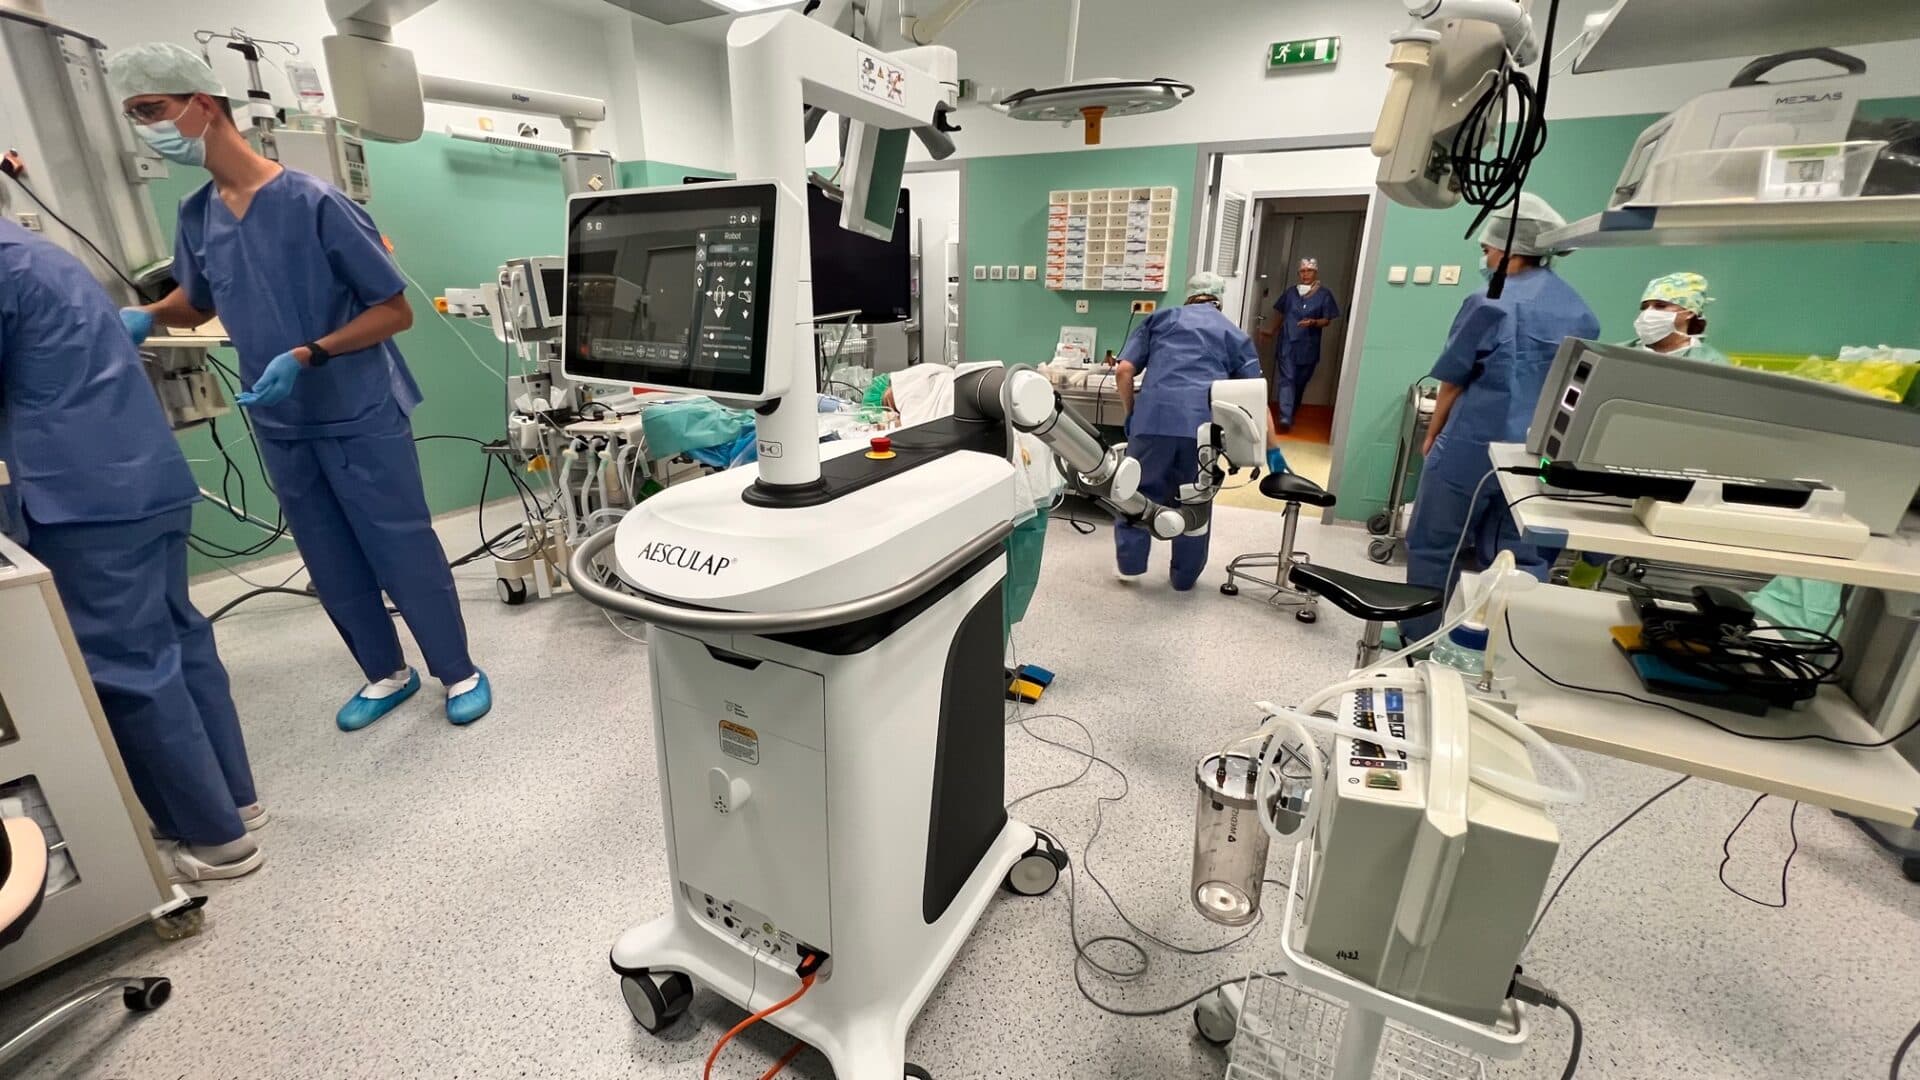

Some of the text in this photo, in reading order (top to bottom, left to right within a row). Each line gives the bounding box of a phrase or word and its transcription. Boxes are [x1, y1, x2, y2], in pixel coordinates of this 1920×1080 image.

[1776, 92, 1842, 105] MEDILAS
[724, 231, 742, 240] Robot
[638, 542, 730, 576] AESCULAP
